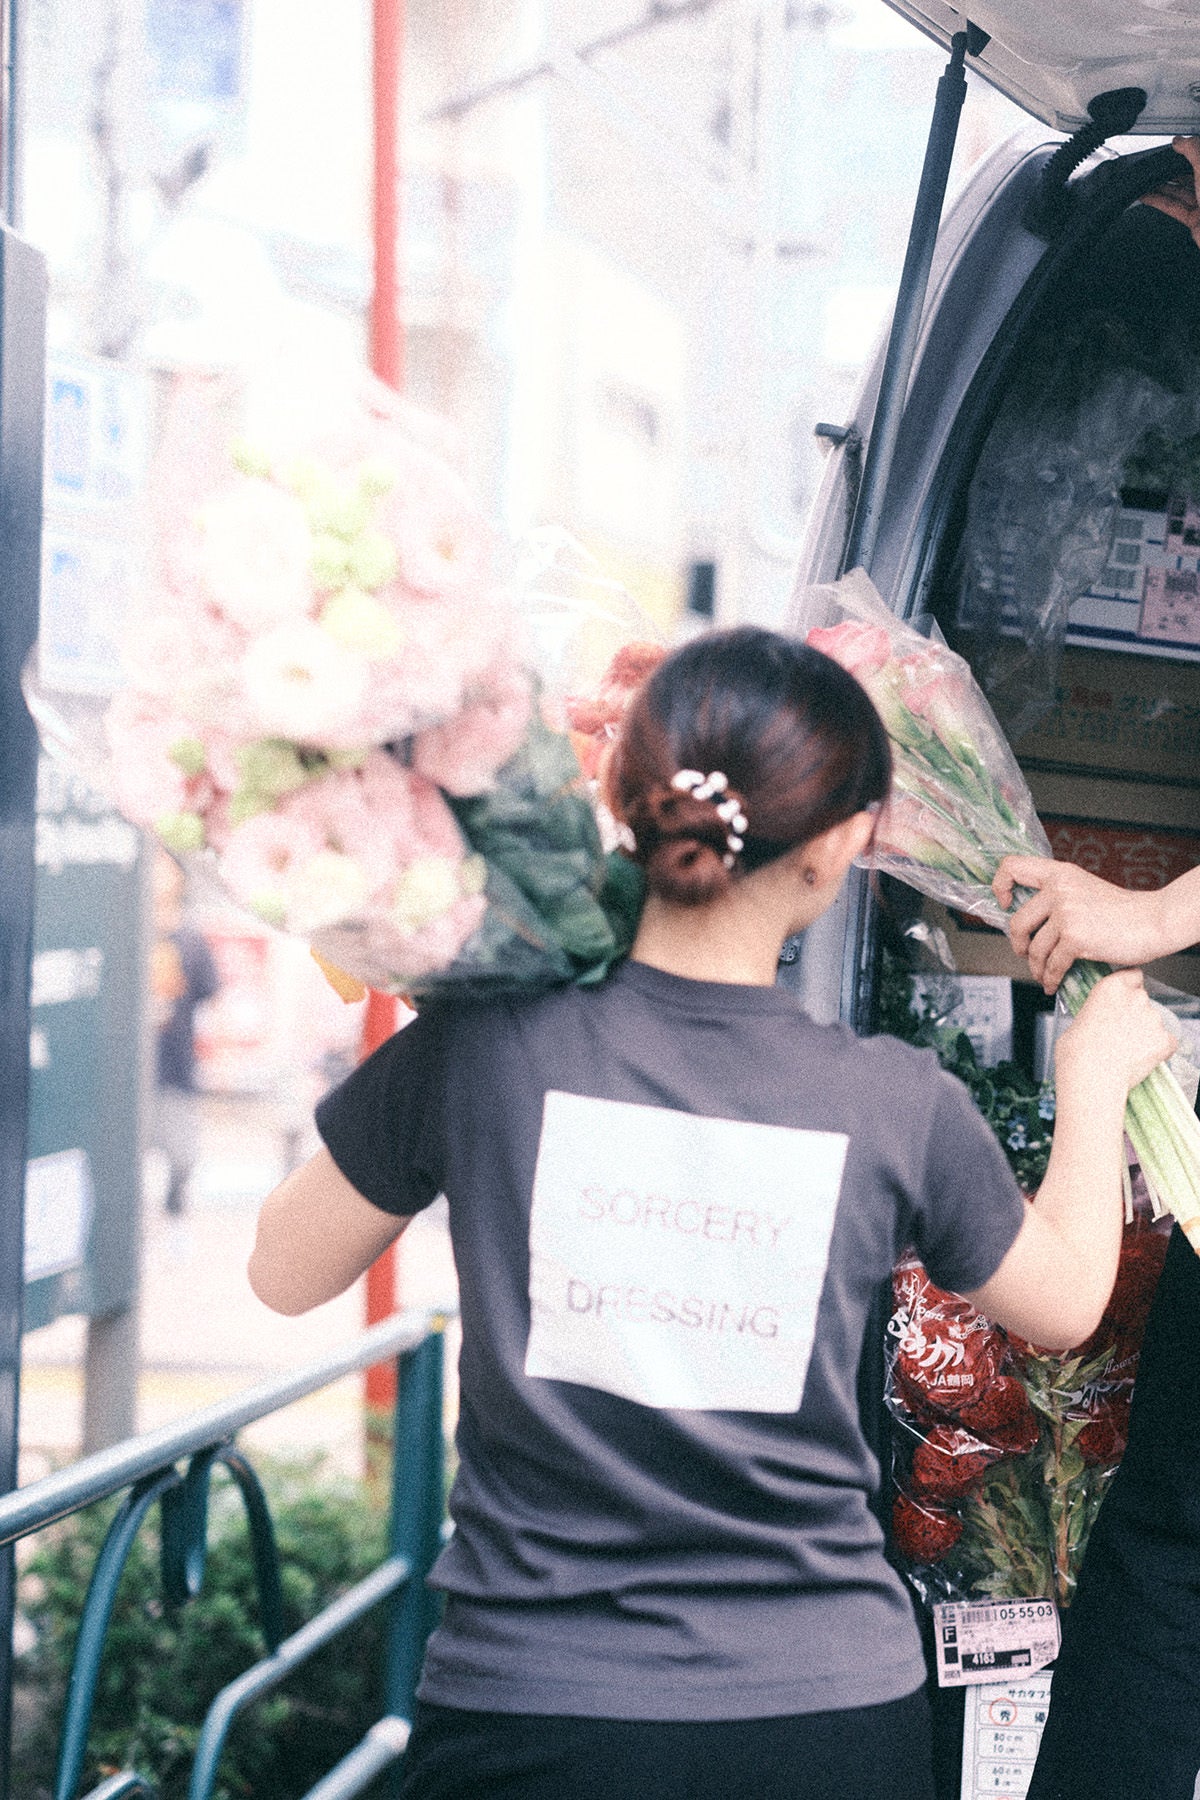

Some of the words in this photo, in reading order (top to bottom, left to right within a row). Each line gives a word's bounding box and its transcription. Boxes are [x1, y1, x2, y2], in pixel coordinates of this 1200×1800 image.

[577, 1184, 791, 1250] SORCERY
[566, 1278, 780, 1339] DRESSING
[945, 1629, 956, 1645] F
[971, 1652, 996, 1666] 4163
